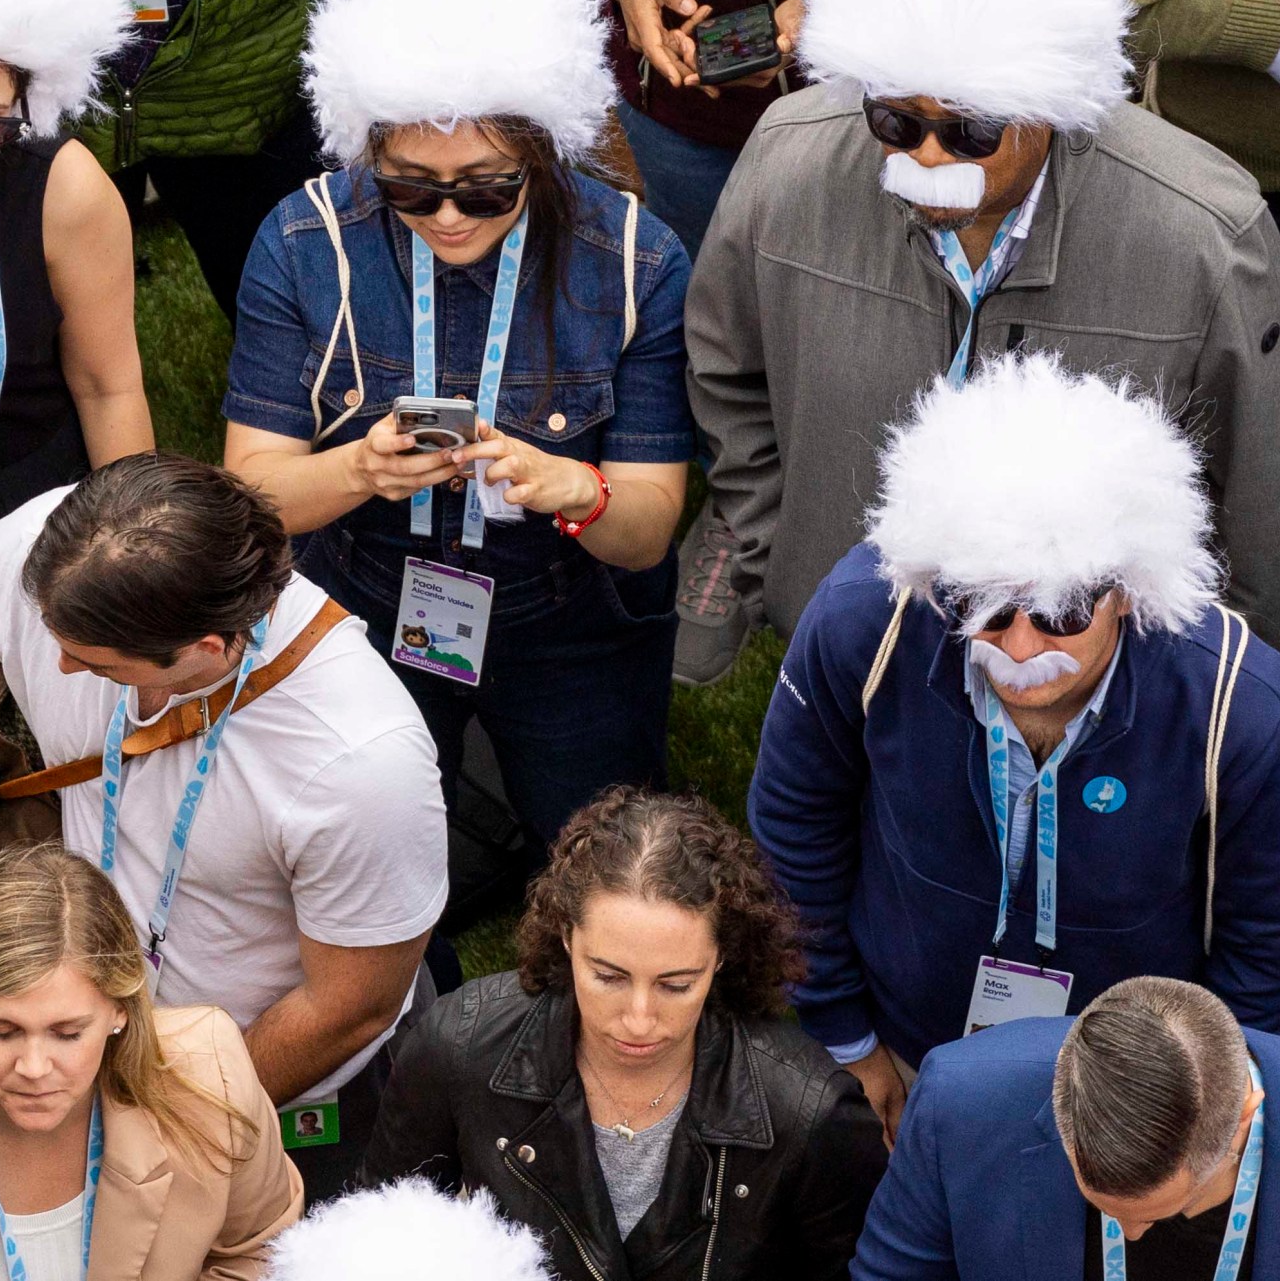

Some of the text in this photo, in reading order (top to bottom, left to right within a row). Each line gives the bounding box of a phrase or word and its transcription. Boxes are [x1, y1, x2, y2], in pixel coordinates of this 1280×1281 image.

[412, 578, 443, 593] Paola
[411, 586, 475, 611] Alcantar Valdes
[399, 651, 449, 674] Salesforce
[984, 978, 1009, 990] Max
